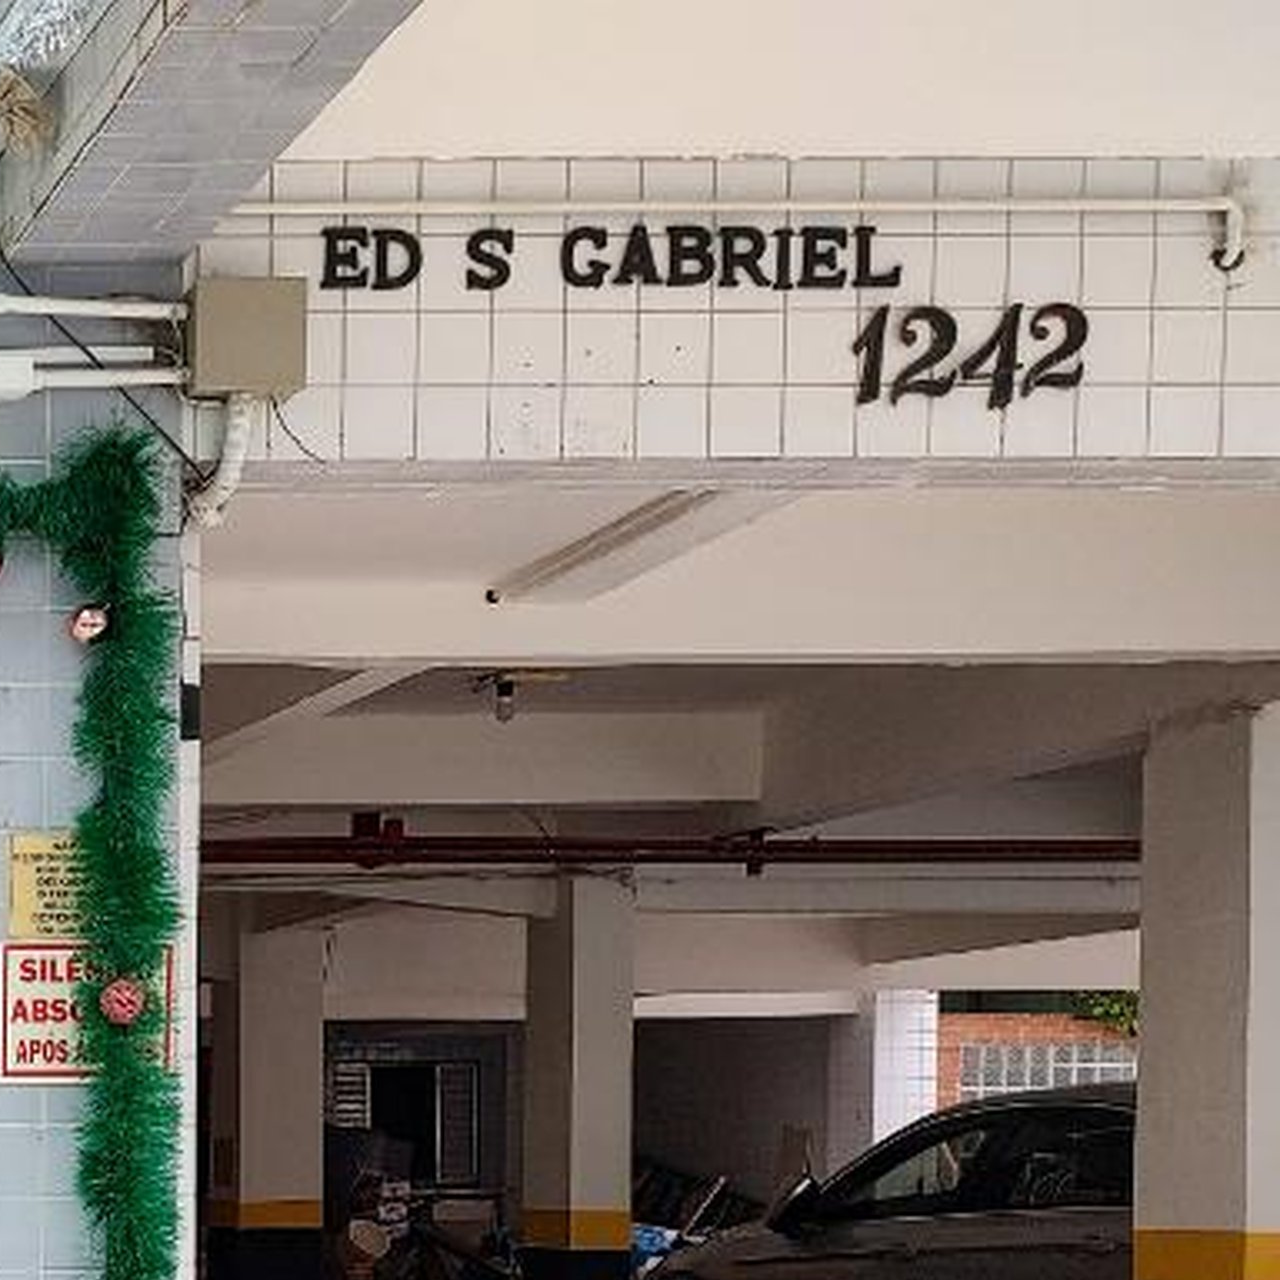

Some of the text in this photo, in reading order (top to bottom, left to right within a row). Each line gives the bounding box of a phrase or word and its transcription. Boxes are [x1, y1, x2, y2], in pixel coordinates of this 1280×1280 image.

[319, 224, 903, 292] ED S GABRIEL
[851, 301, 1091, 411] 1242
